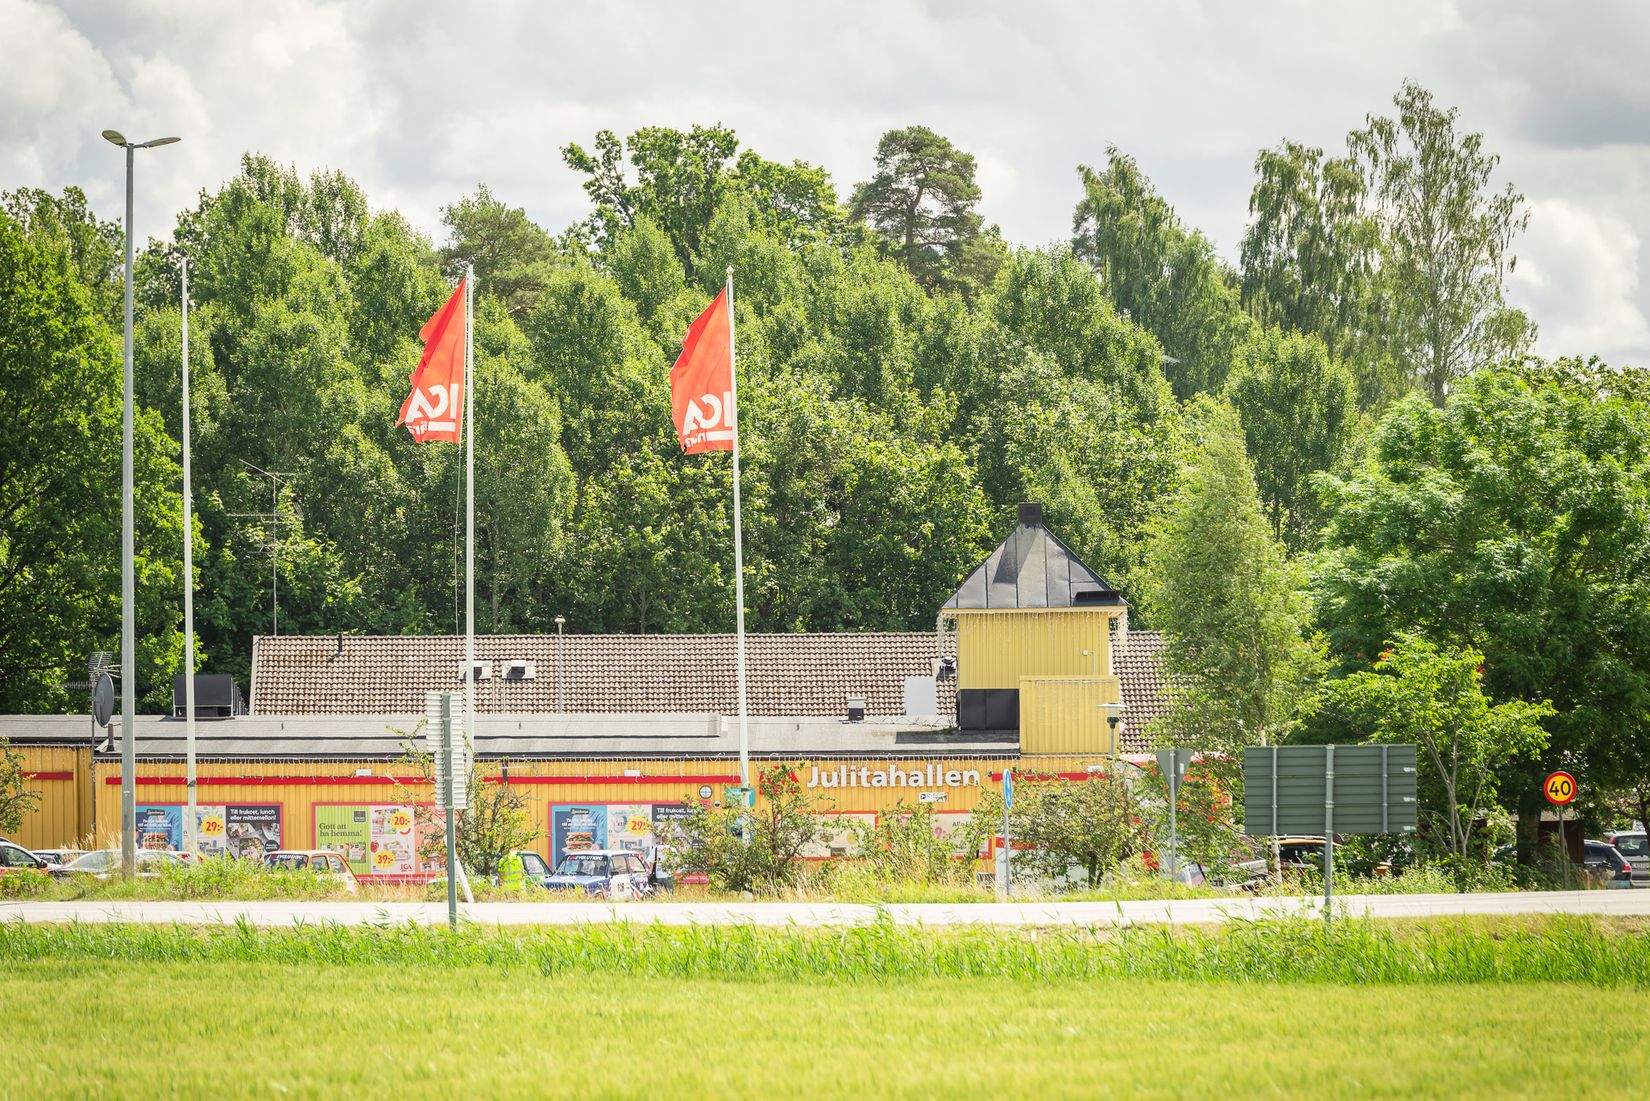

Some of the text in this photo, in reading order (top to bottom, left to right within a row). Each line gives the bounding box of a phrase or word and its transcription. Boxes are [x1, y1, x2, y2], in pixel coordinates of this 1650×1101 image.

[807, 763, 981, 789] Julitahallen
[1549, 780, 1572, 797] 40
[394, 816, 411, 825] 20:-
[206, 821, 223, 832] 29:-
[319, 822, 336, 830] Gott
[377, 855, 394, 864] 39:-
